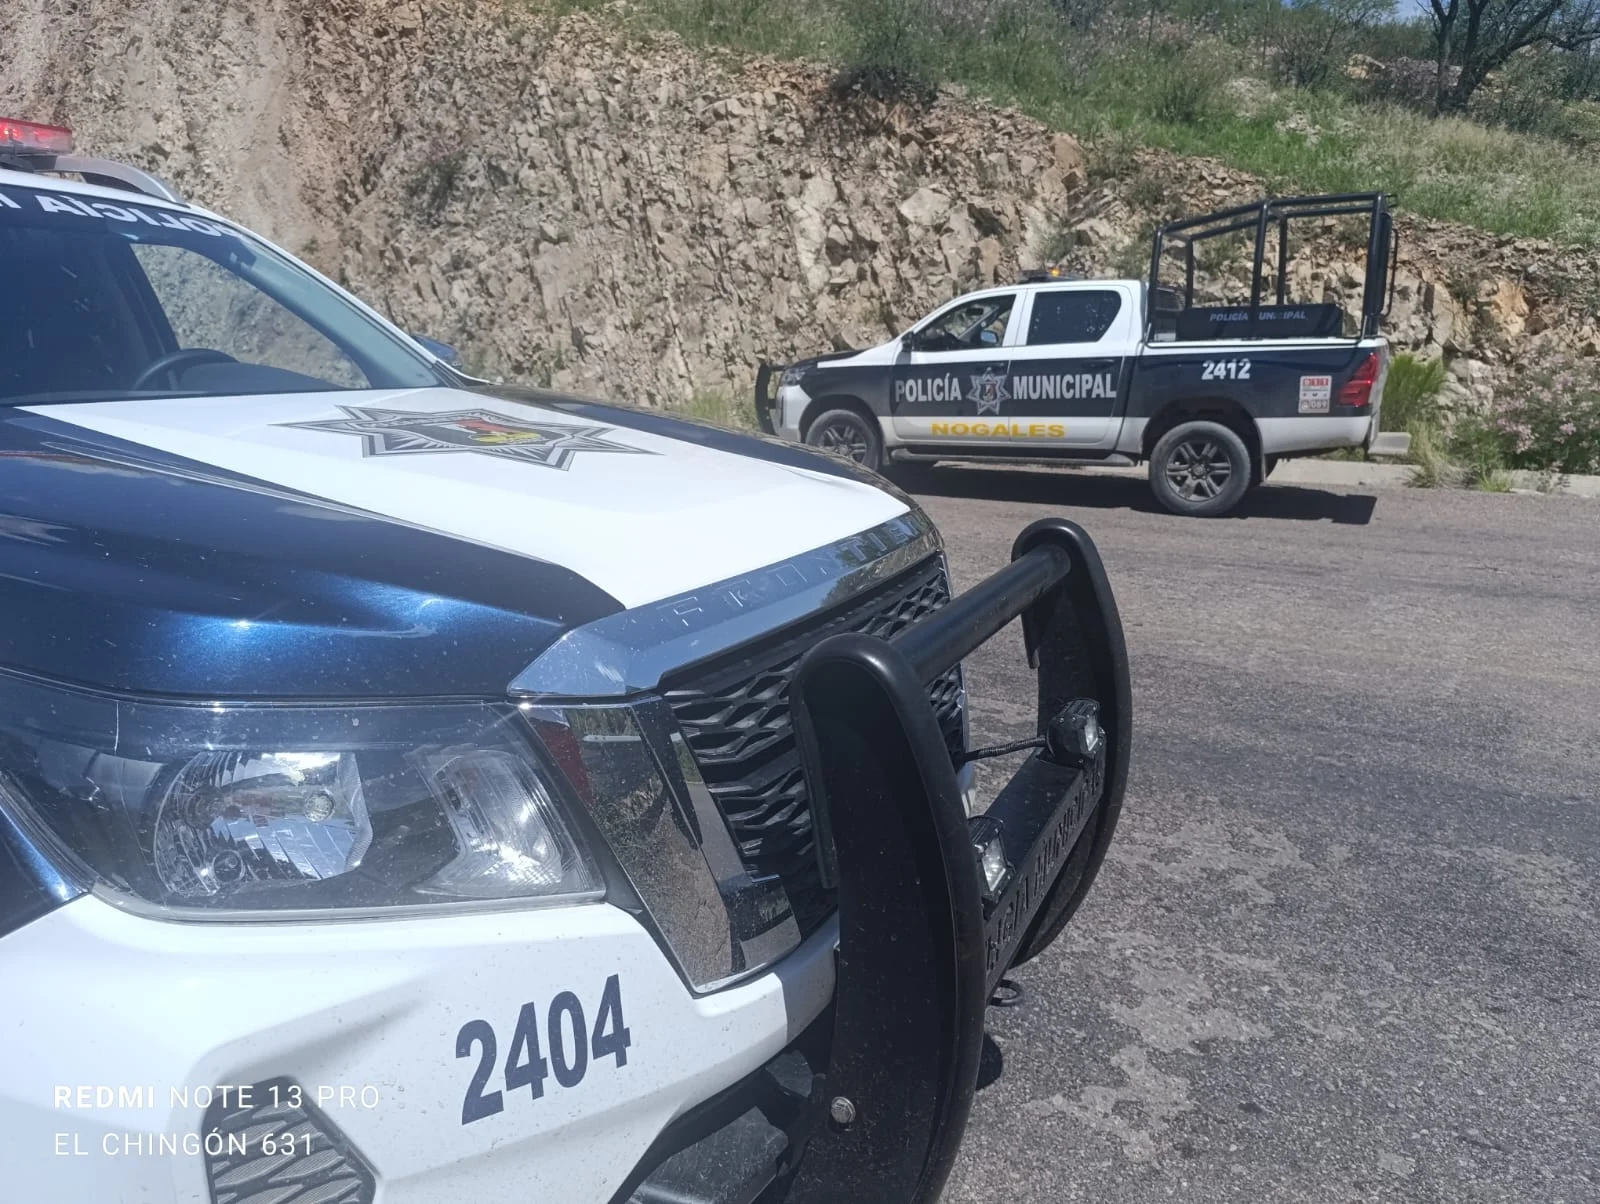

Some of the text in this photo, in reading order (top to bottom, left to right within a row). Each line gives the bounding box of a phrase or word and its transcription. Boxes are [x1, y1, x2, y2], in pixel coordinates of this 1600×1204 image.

[1209, 310, 1249, 321] POLICÍA
[1201, 358, 1251, 380] 2412
[895, 373, 1117, 402] POLICÍA MUNICIPAL
[930, 423, 1065, 437] NOGALES
[455, 974, 631, 1125] 2404
